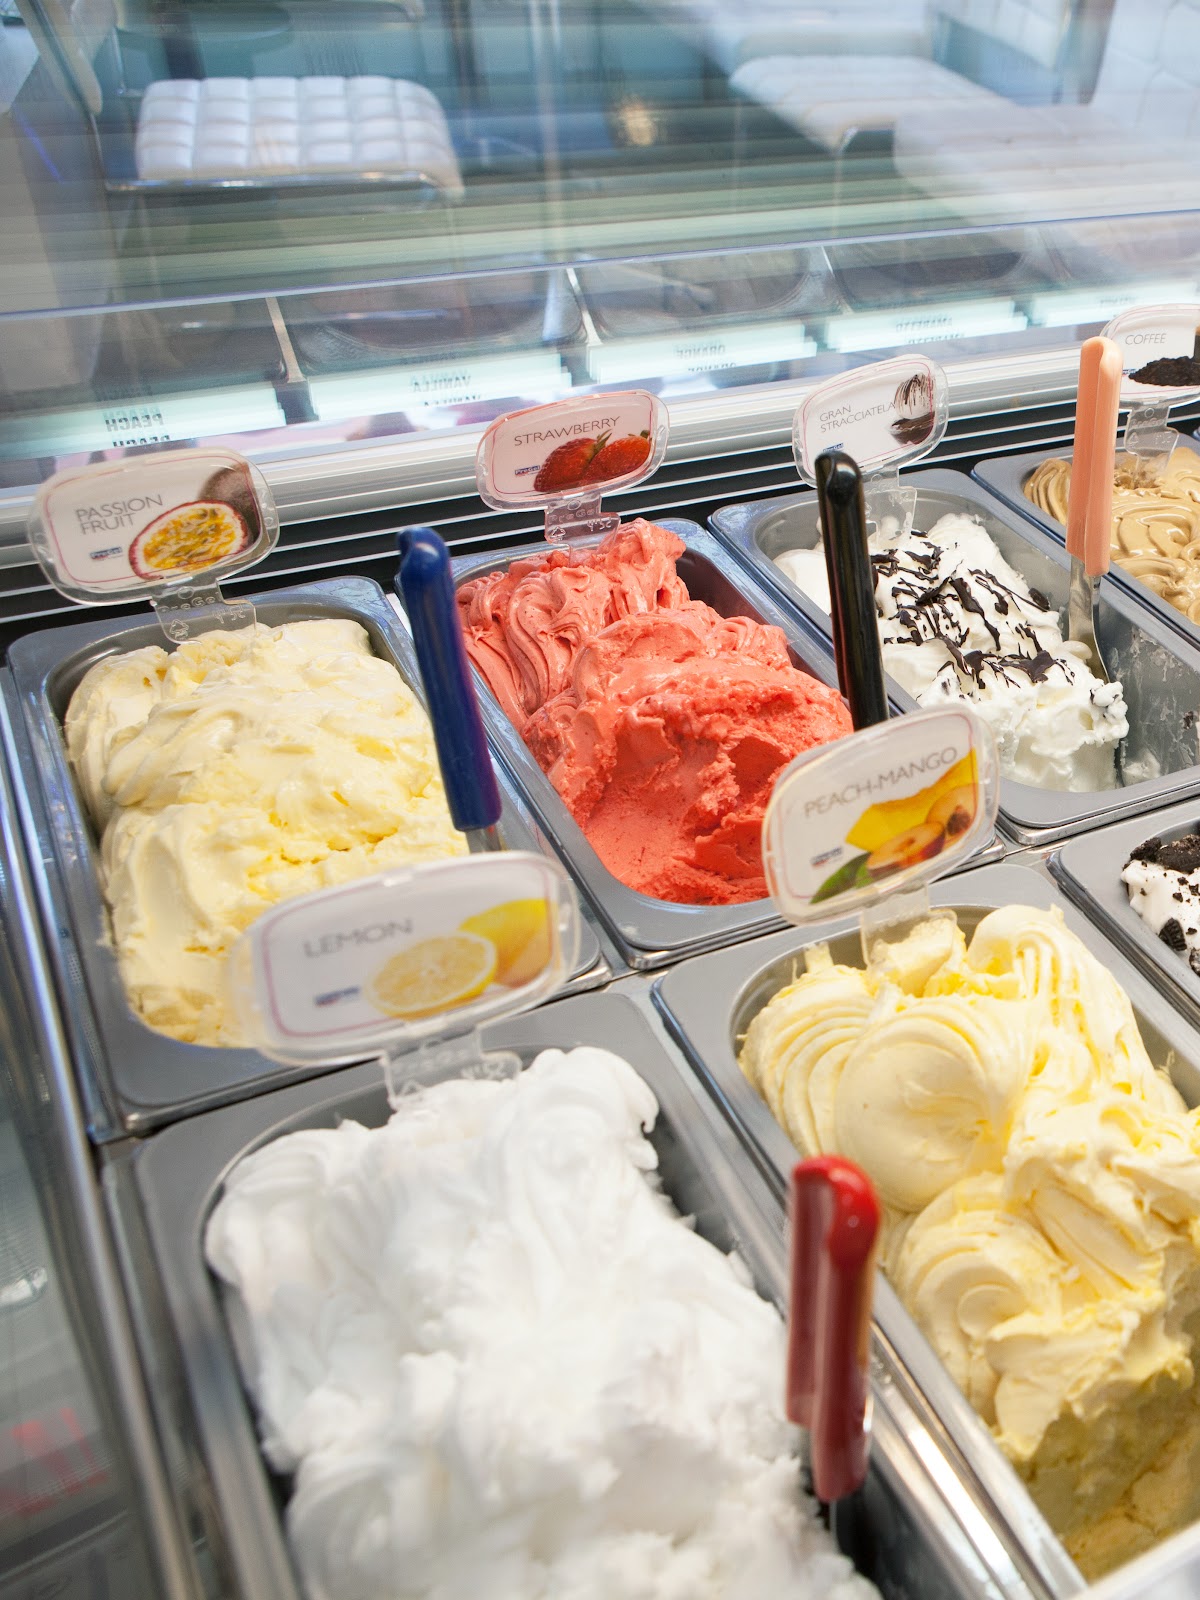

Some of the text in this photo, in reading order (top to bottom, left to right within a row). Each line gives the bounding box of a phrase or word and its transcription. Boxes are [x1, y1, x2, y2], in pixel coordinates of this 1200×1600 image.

[1125, 333, 1167, 345] COFFEE
[819, 404, 852, 422] GRAN
[514, 416, 620, 446] STRAWBERRY
[75, 494, 163, 522] PASSION
[80, 513, 137, 535] FRUIT
[804, 746, 958, 818] PEACH-MANGO
[303, 918, 413, 959] LEMON
